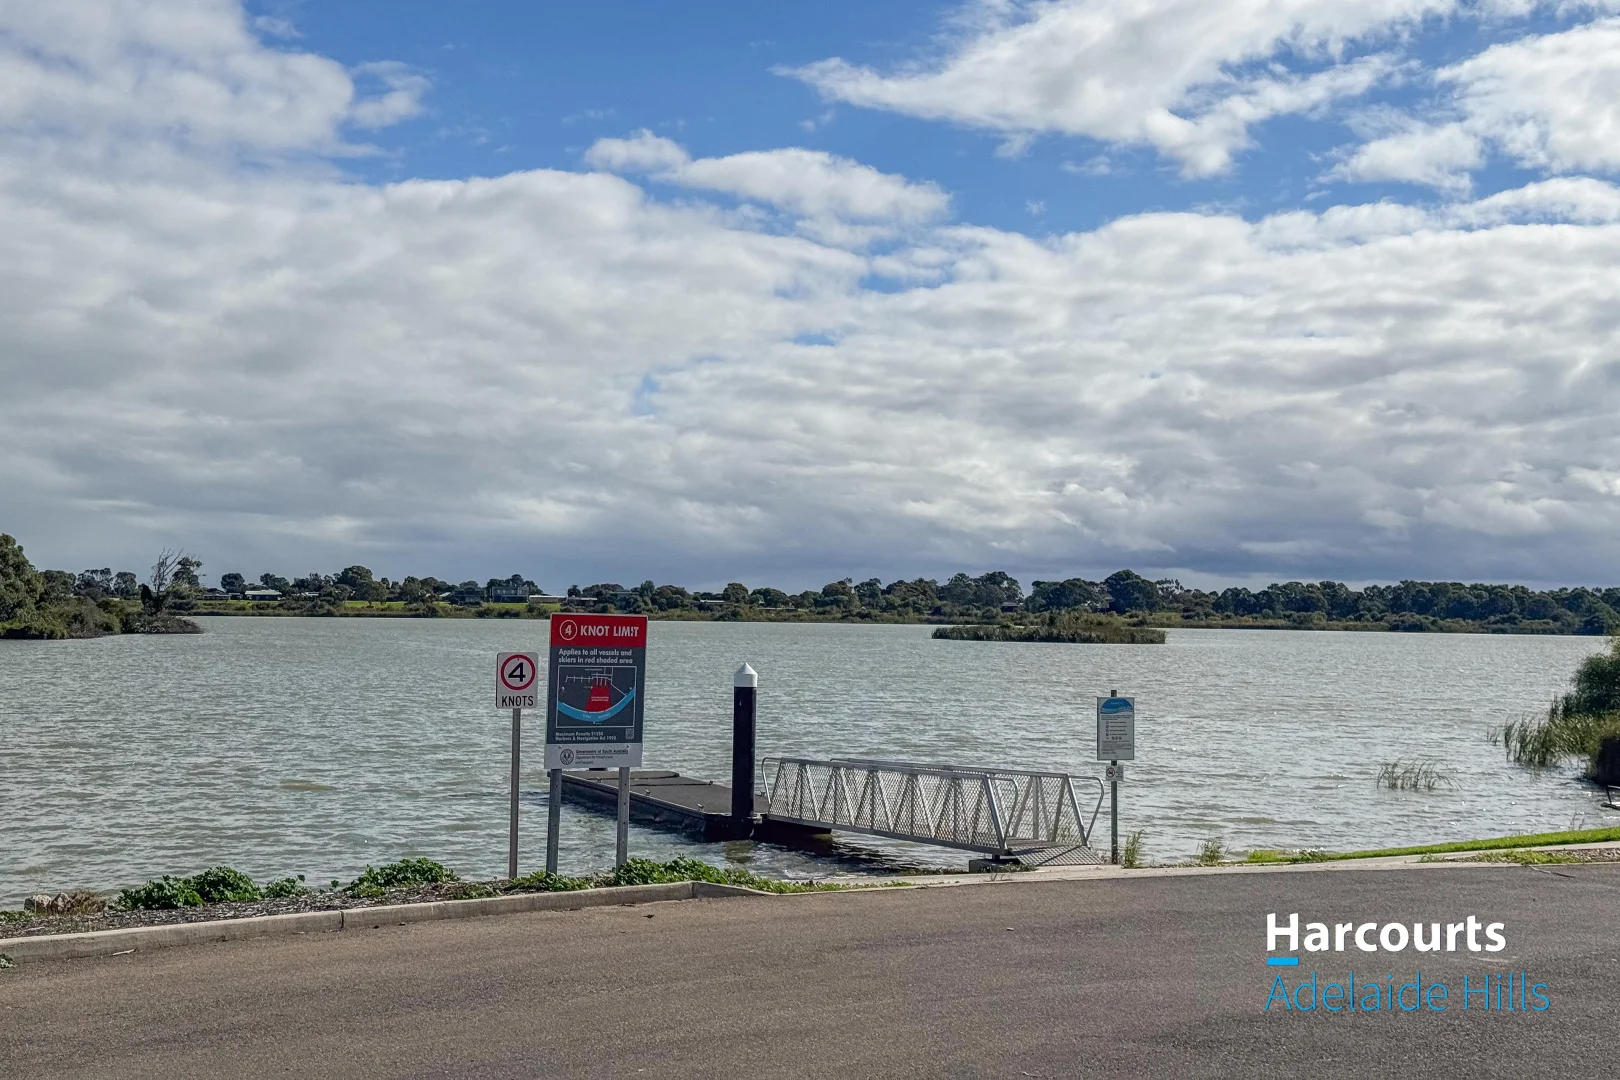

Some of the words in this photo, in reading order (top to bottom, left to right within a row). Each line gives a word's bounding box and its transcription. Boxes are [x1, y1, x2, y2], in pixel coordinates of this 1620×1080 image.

[564, 625, 572, 636] 4
[580, 626, 610, 636] KNOT
[613, 626, 639, 637] LIMIT
[508, 662, 526, 682] 4
[501, 696, 534, 707] KNOTS
